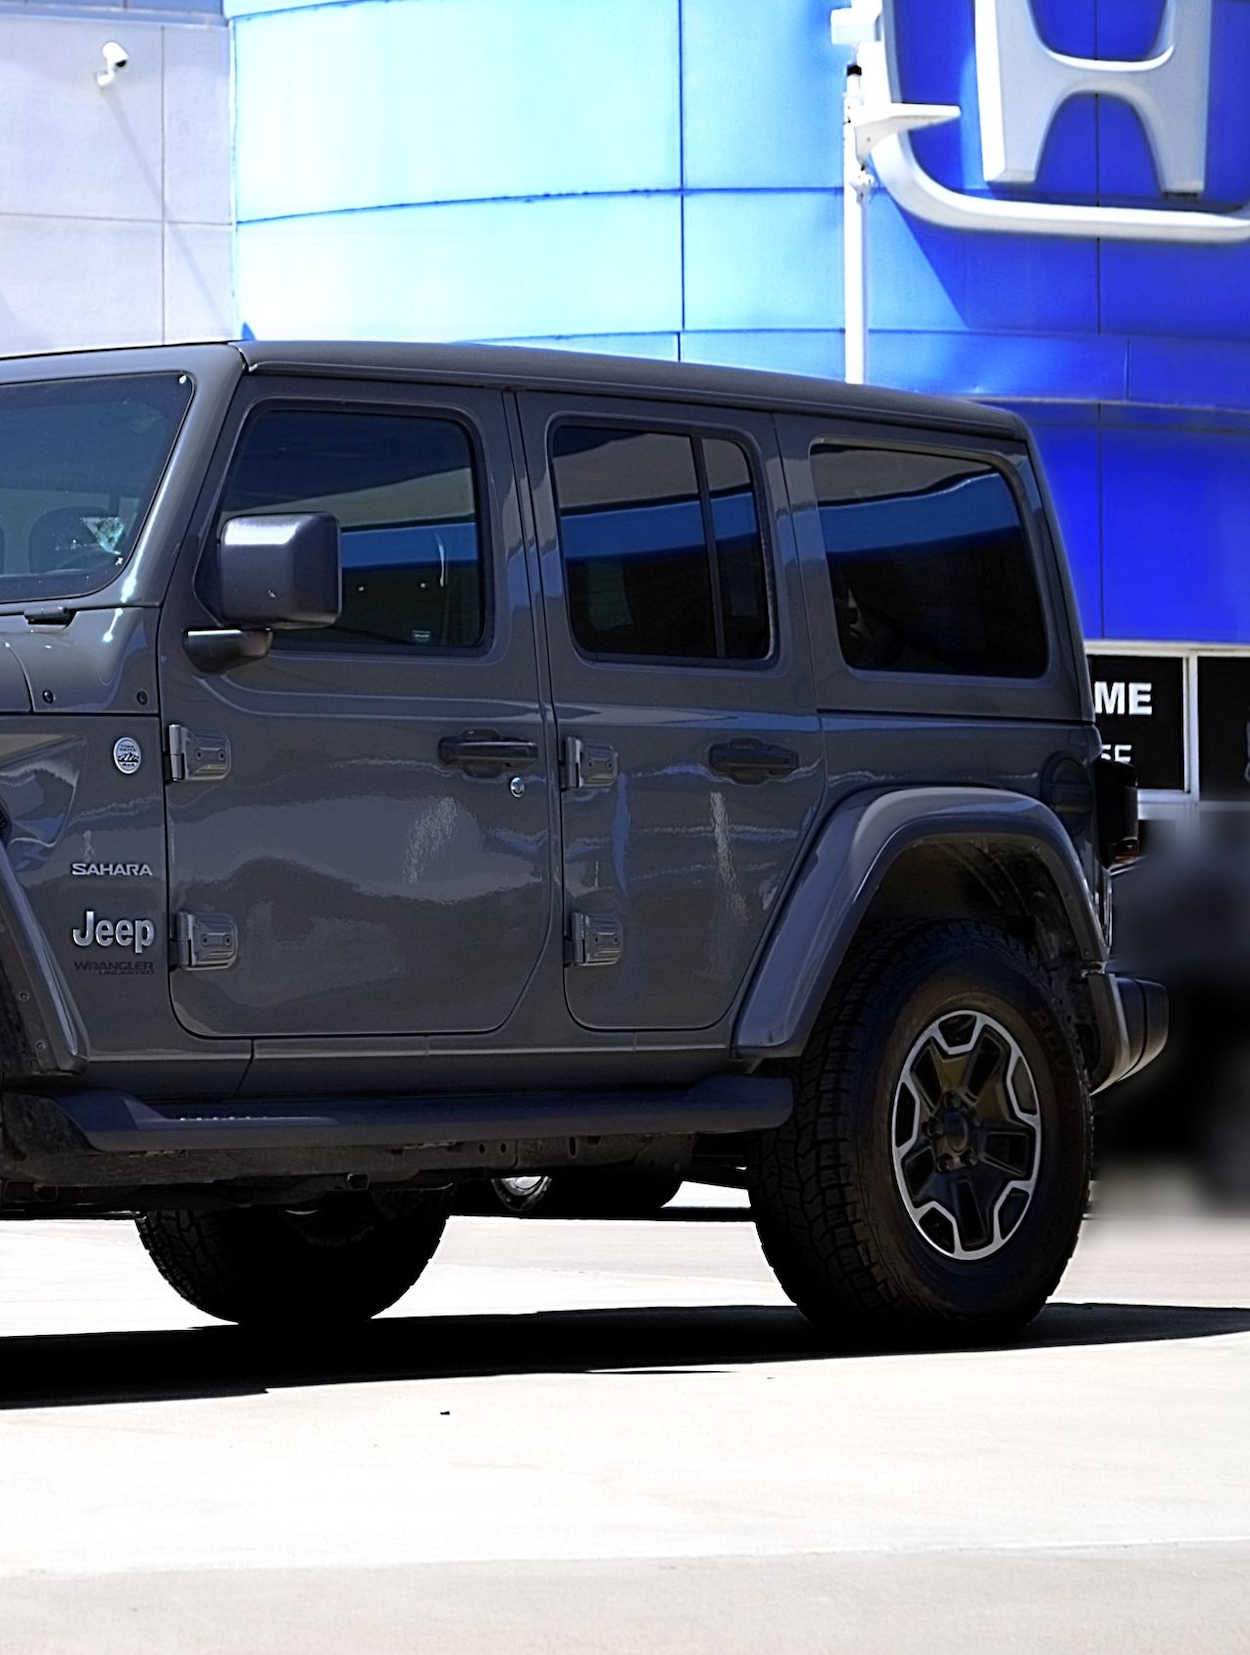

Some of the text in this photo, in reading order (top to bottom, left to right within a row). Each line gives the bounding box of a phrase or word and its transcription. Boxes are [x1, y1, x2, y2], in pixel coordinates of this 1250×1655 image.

[71, 863, 153, 876] SAHARA
[72, 911, 155, 953] Jeep
[73, 960, 154, 971] WRANGLER
